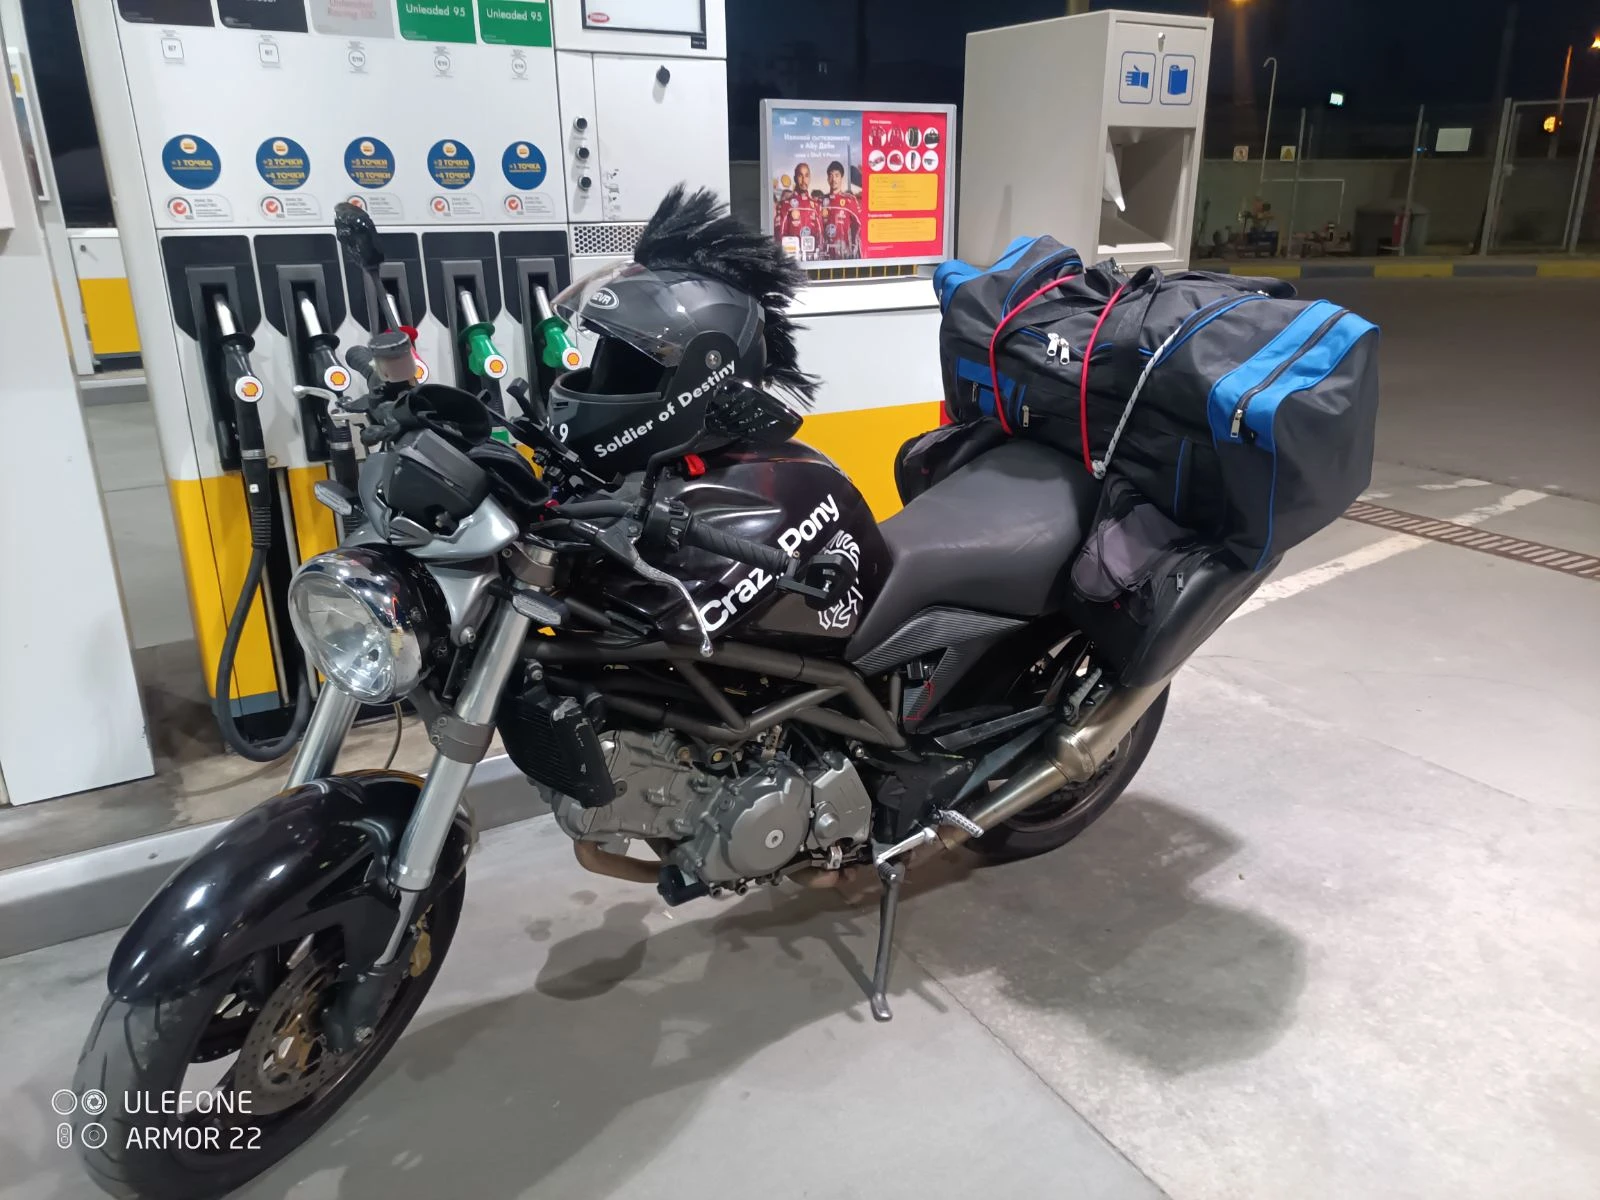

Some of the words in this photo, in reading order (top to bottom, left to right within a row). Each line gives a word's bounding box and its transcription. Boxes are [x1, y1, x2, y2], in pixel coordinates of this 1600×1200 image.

[406, 4, 450, 16] Unleaded
[453, 6, 466, 17] 95
[487, 8, 528, 21] Unleaded
[530, 11, 543, 22] 95
[594, 418, 655, 459] Soldier
[658, 401, 677, 423] of
[677, 359, 736, 408] Destiny
[698, 567, 781, 633] Craz
[777, 493, 840, 558] Pony
